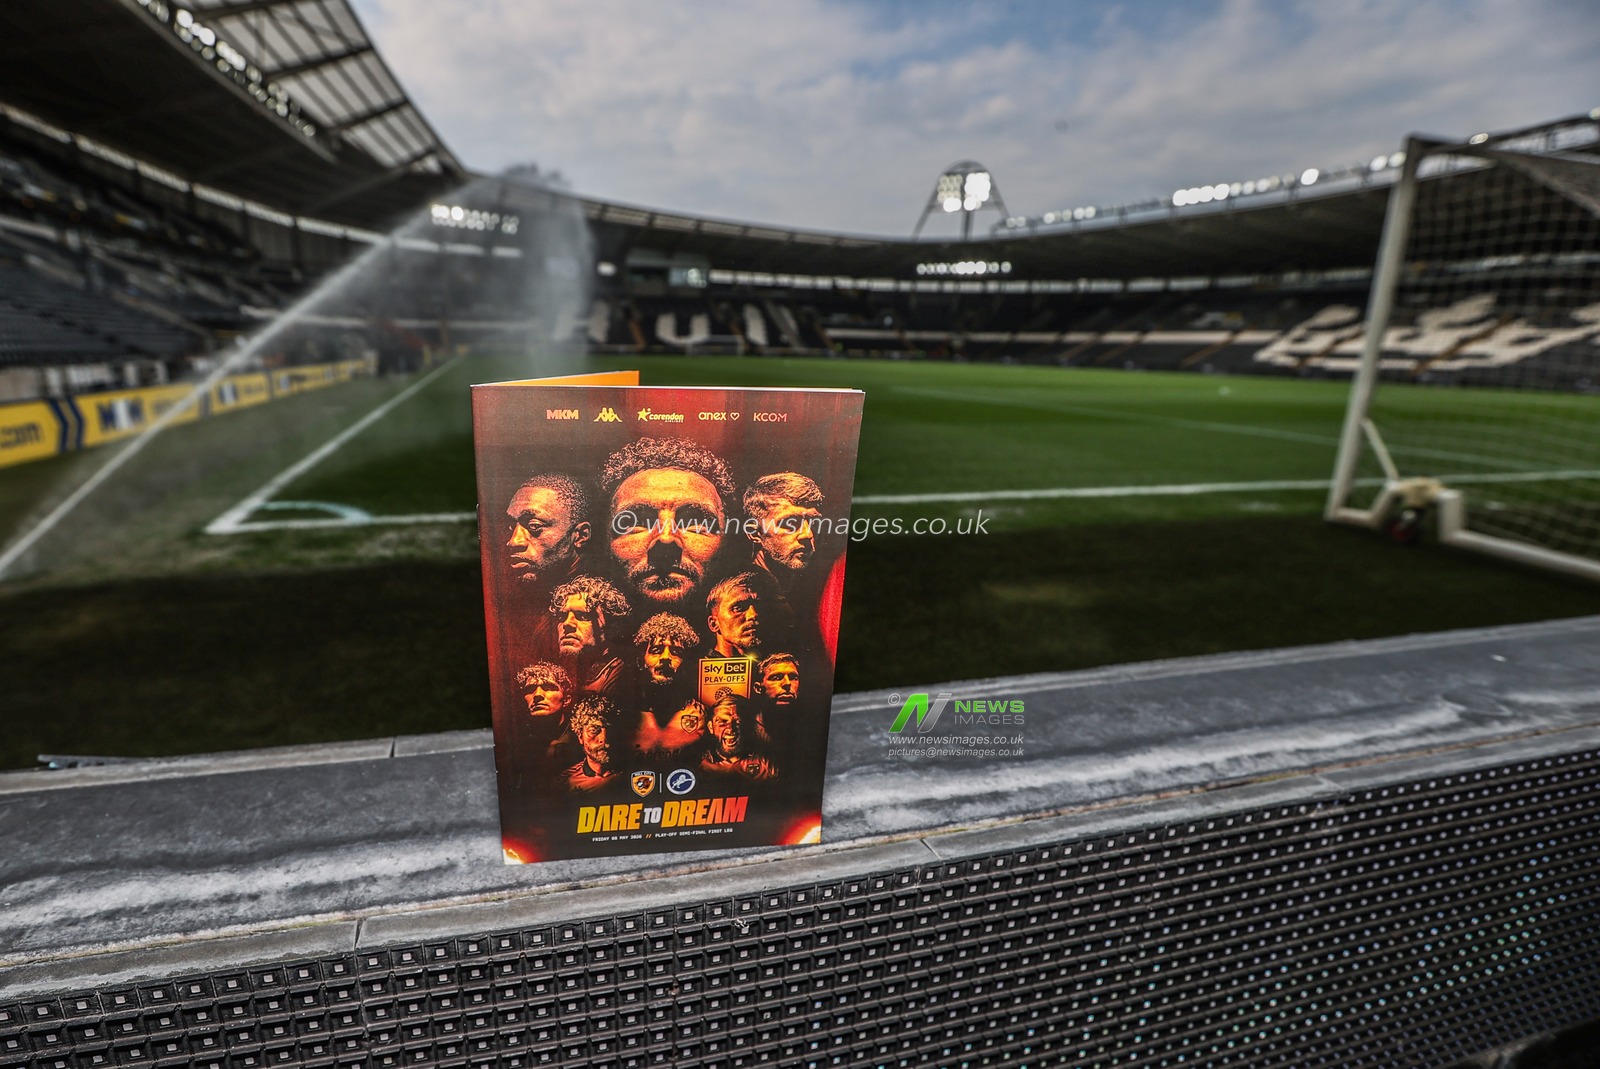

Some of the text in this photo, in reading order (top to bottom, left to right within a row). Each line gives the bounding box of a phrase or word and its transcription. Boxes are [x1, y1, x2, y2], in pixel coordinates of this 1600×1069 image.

[546, 409, 579, 420] MKM
[649, 411, 684, 421] corendon
[698, 411, 727, 421] anex
[753, 412, 788, 422] KCOM
[704, 663, 745, 674] sky bet
[704, 674, 746, 683] PLAY-OFFS
[577, 796, 749, 834] DARE TO DREAM
